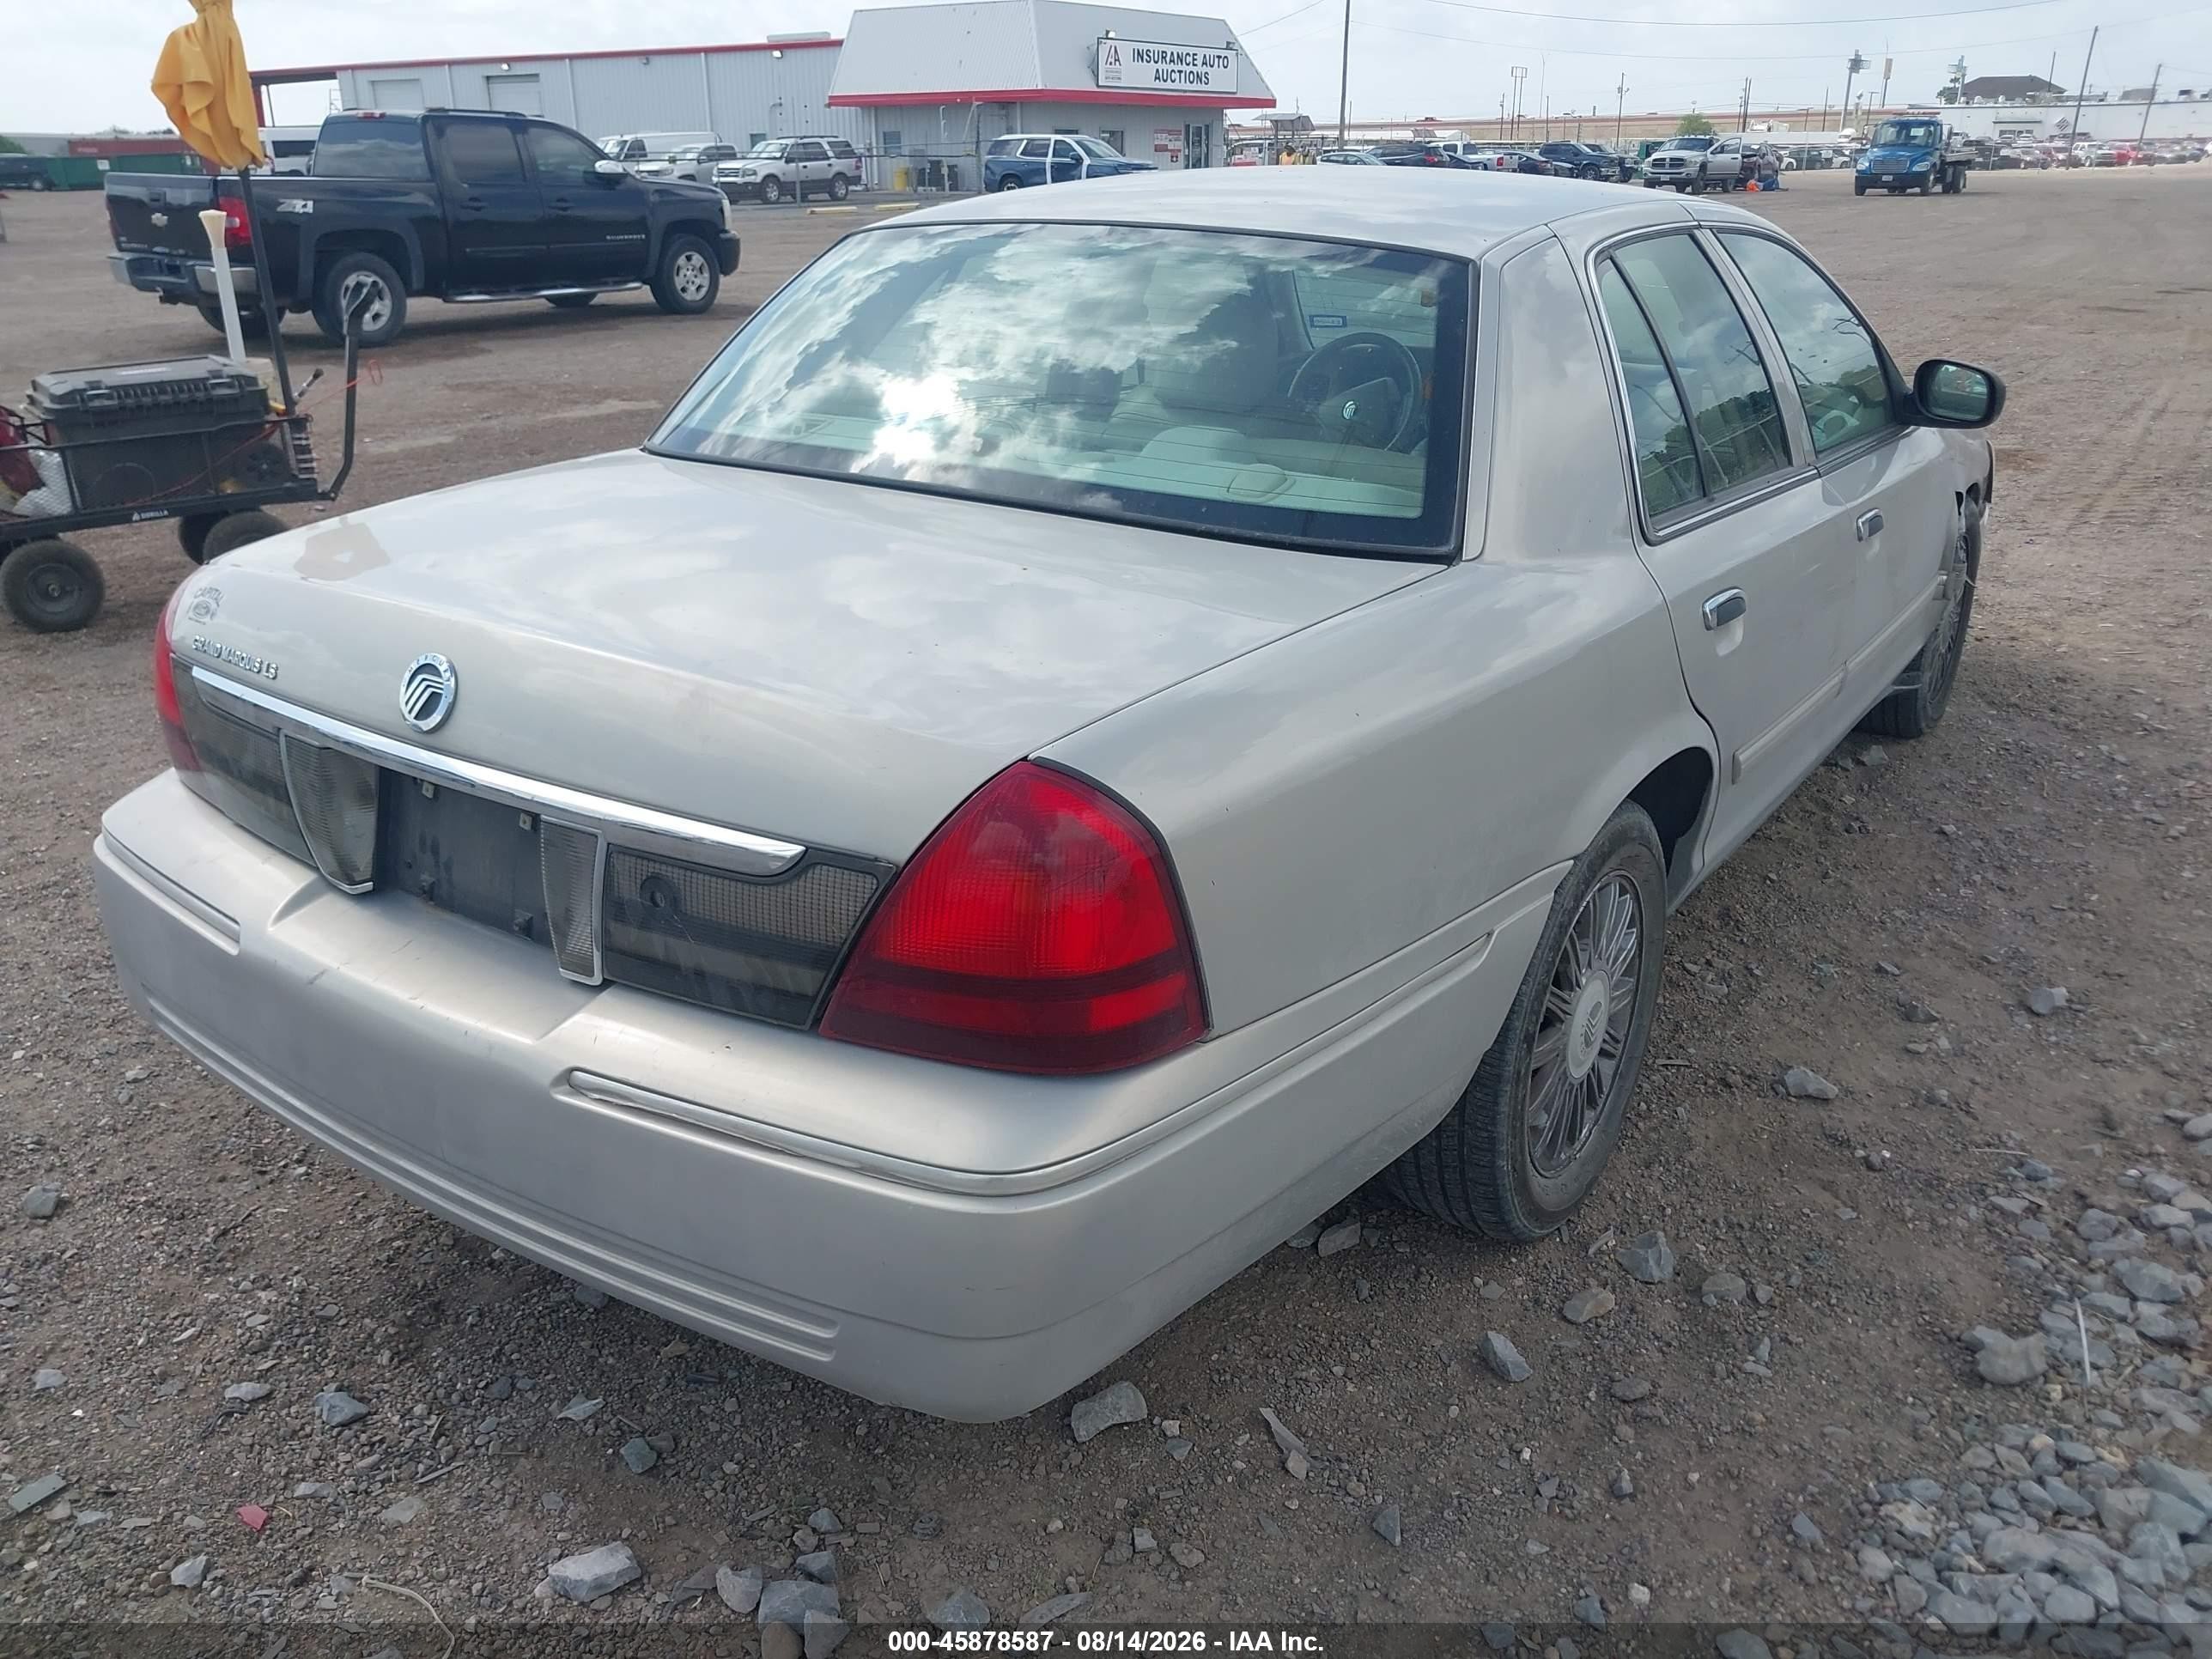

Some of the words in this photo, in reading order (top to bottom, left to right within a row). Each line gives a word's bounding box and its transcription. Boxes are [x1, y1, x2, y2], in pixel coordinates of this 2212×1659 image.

[1132, 47, 1198, 67] INSURANCE
[1200, 53, 1230, 70] AUTO
[1153, 68, 1210, 85] AUCTIONS
[191, 635, 222, 659] GRAND
[222, 645, 263, 674] MARQUIS
[263, 661, 278, 680] LS
